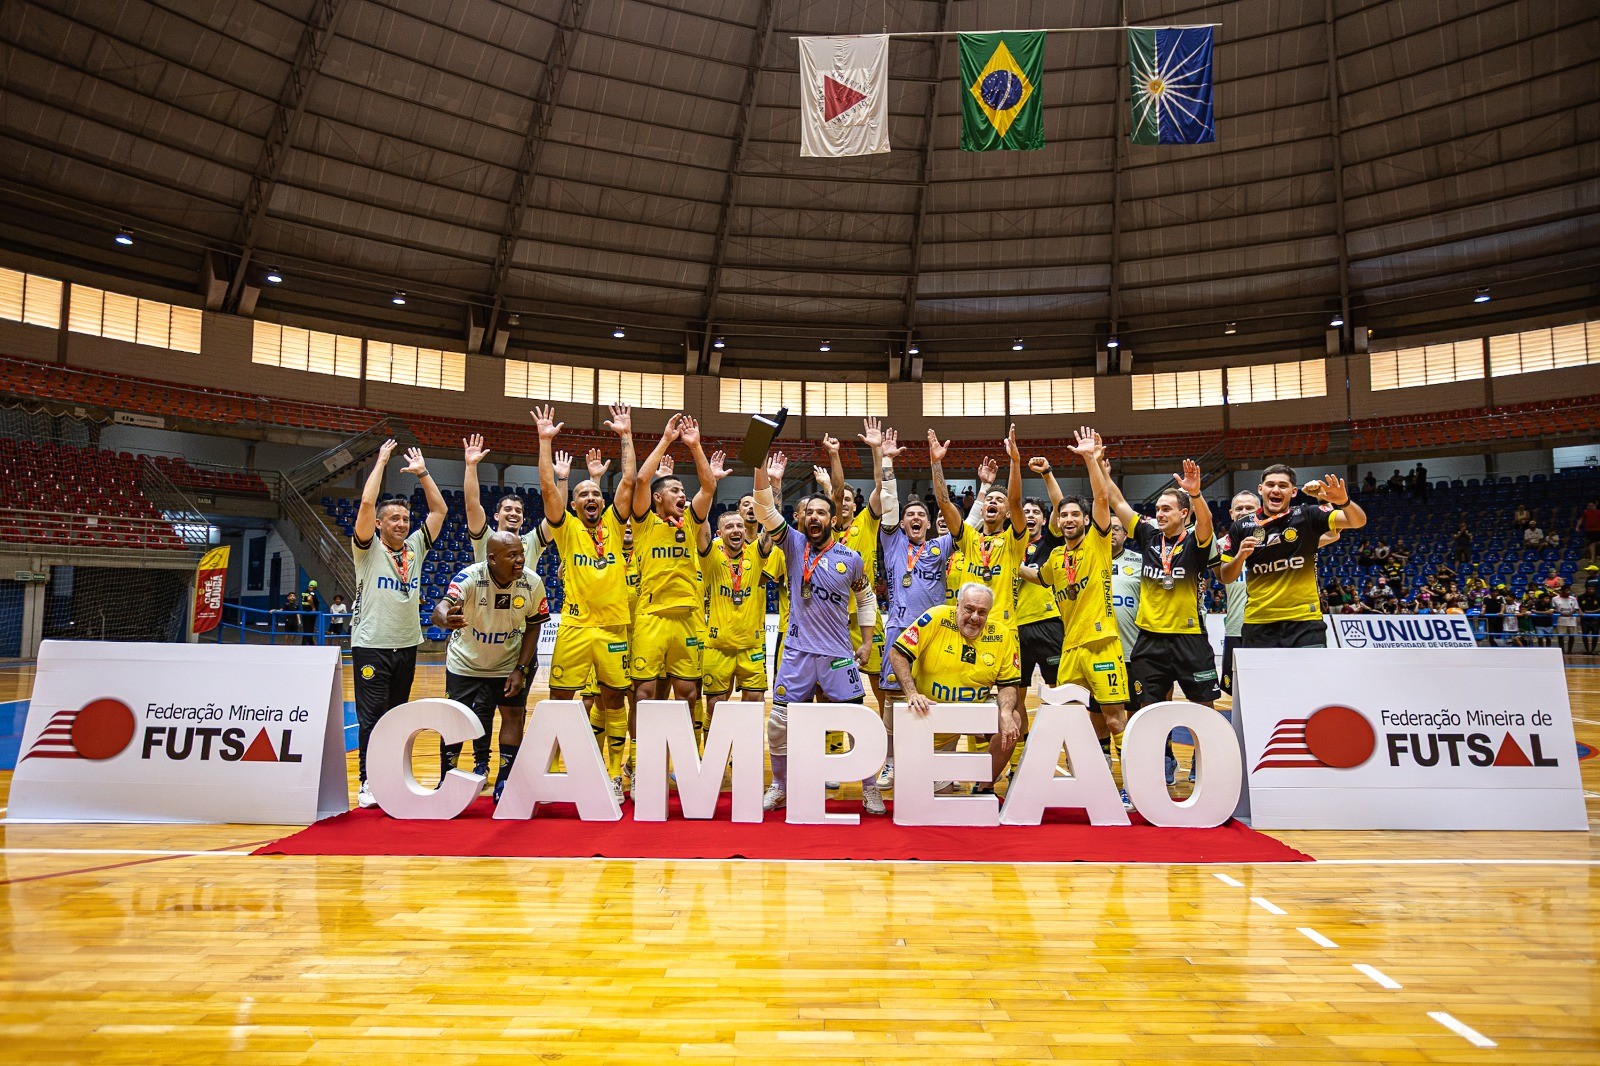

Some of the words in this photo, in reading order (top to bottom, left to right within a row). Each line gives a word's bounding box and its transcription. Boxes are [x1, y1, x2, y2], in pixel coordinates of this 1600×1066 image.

[204, 576, 213, 604] CAFÉ
[1366, 619, 1471, 641] UNIUBE
[847, 667, 860, 684] 30
[1107, 673, 1118, 687] 12
[147, 703, 223, 723] Federação
[230, 704, 283, 721] Mineira
[289, 705, 308, 722] de
[1381, 710, 1460, 729] Federação
[1467, 710, 1525, 726] Mineira
[1531, 710, 1552, 726] de
[141, 726, 303, 762] FUTSAL
[366, 681, 1242, 828] CAMPEÃO
[1386, 731, 1558, 767] FUTSAL
